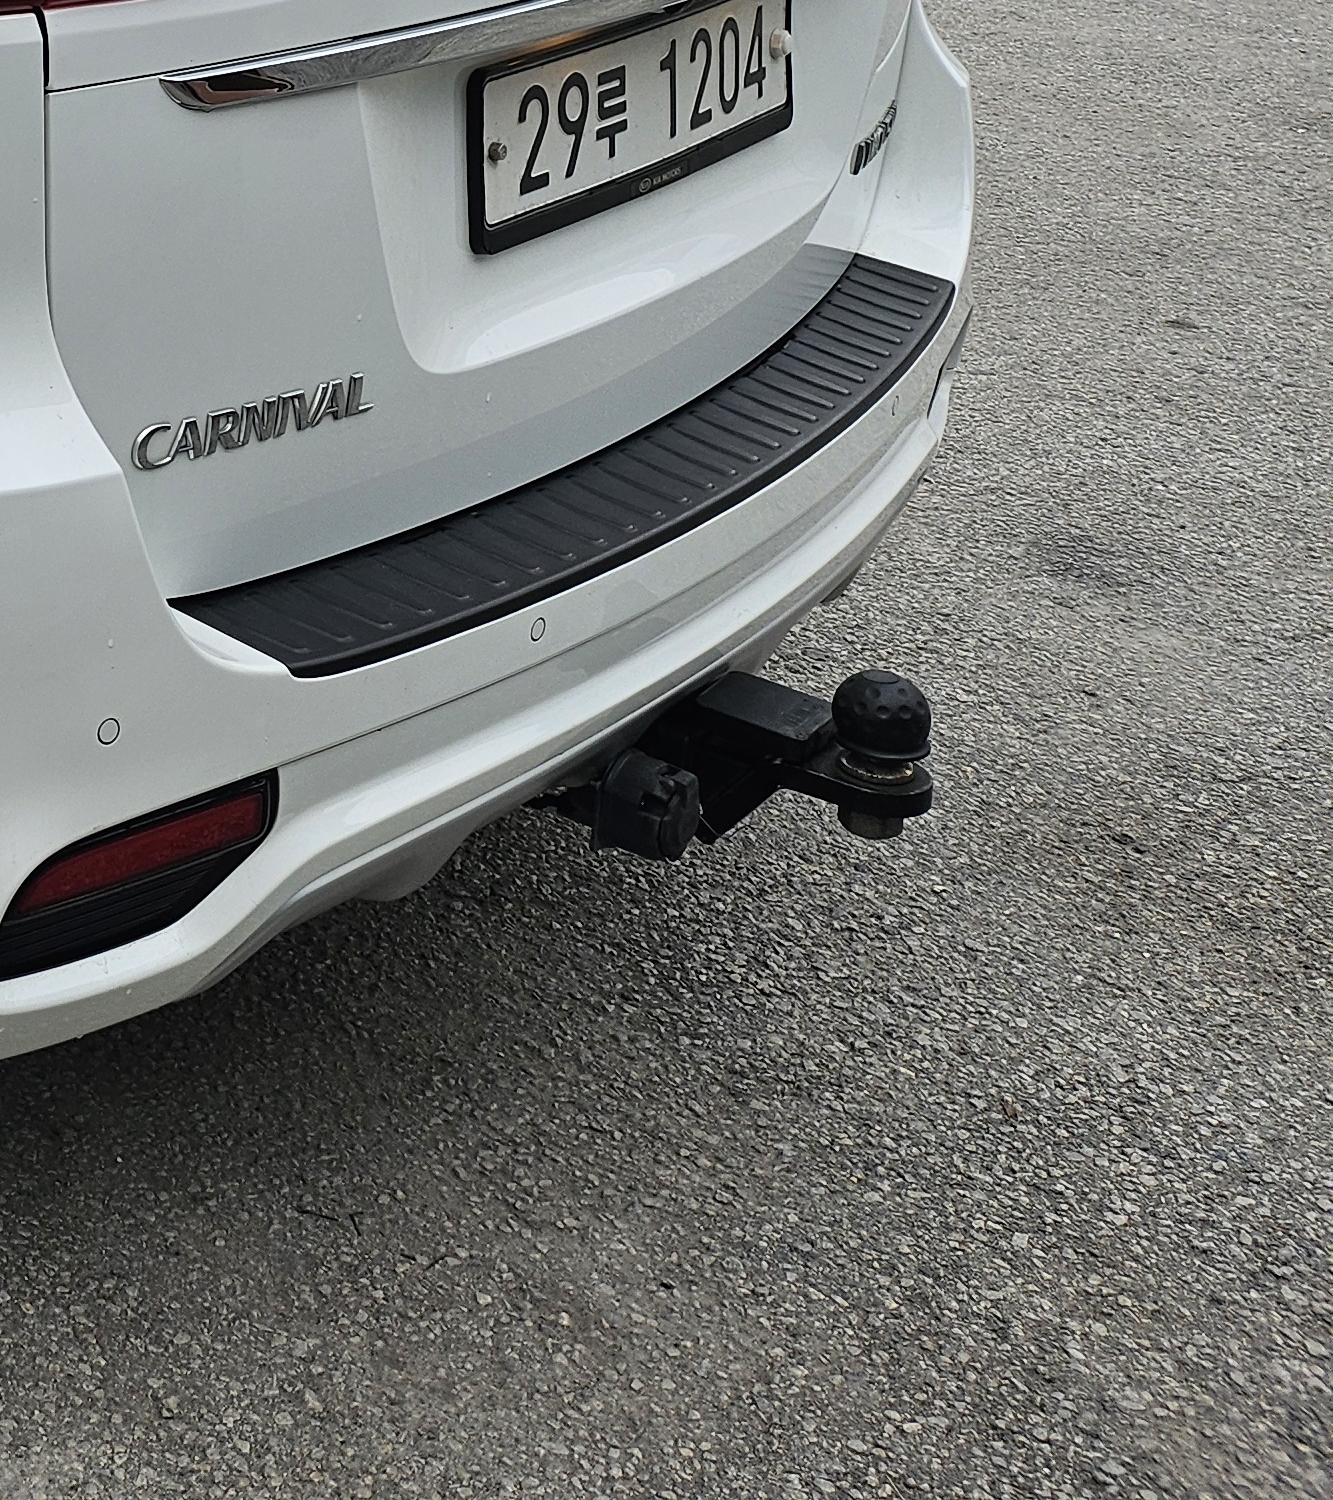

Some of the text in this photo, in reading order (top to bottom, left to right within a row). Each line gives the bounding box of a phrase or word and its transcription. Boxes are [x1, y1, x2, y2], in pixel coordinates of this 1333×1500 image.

[517, 64, 629, 196] 29루
[659, 4, 767, 139] 1204
[131, 371, 375, 471] CARNIVAL
